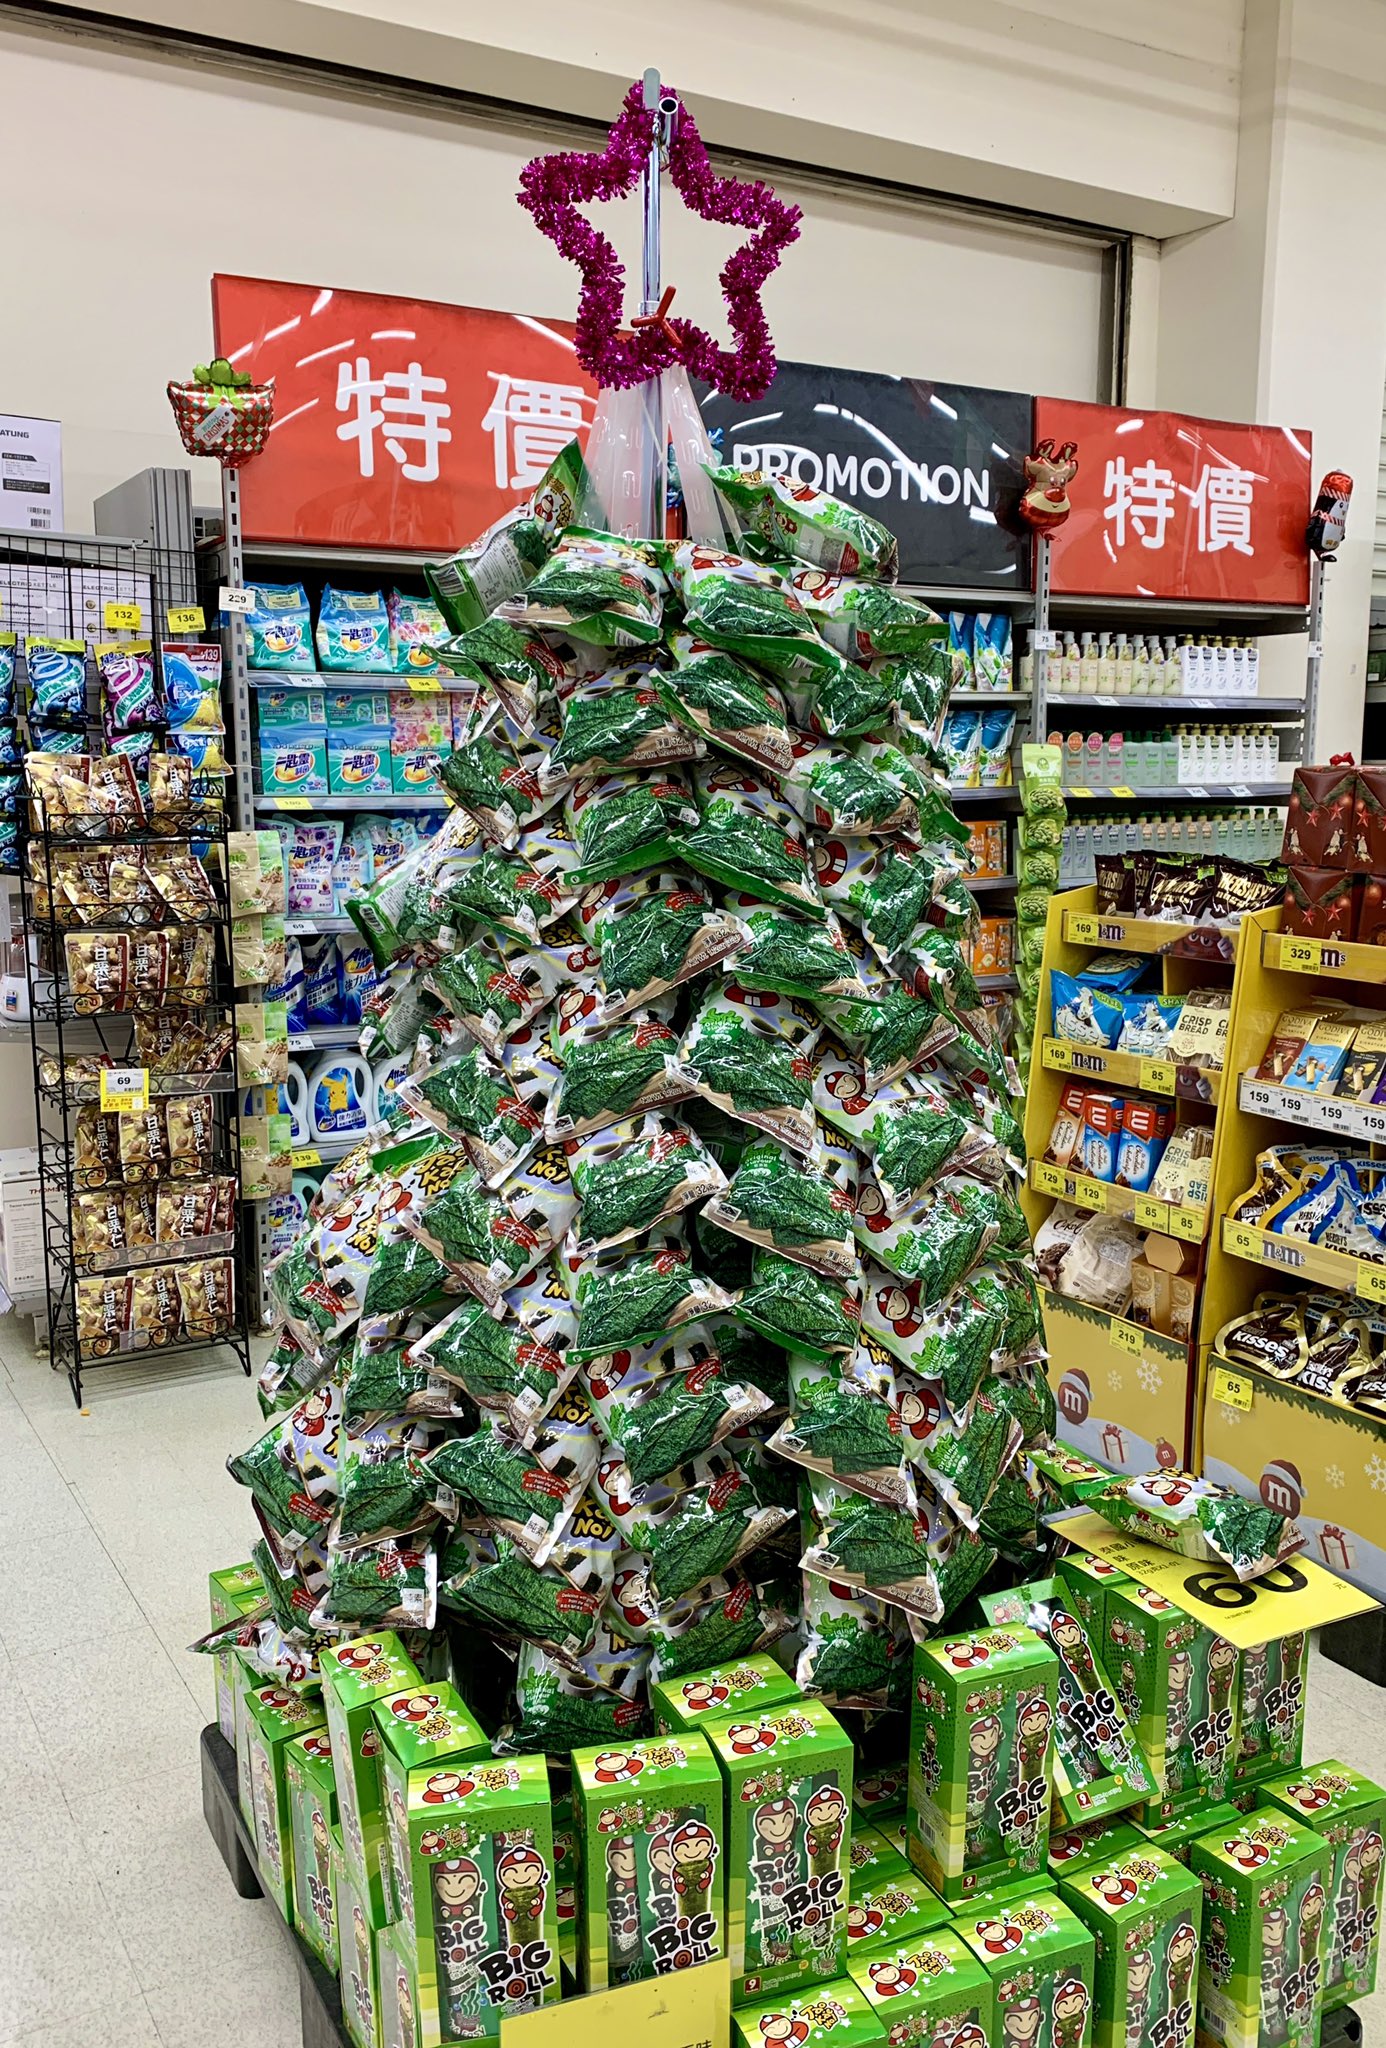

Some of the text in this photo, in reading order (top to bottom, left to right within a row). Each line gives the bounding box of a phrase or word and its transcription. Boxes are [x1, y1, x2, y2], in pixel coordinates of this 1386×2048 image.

[335, 356, 586, 490] 特價
[732, 443, 990, 507] PROMOTION
[1103, 455, 1255, 557] 特價
[228, 594, 247, 604] 229
[114, 610, 133, 620] 132
[176, 614, 195, 623] 136
[274, 753, 314, 771] 一匙靈
[341, 754, 379, 771] 一匙靈
[1075, 924, 1091, 934] 169
[1290, 947, 1311, 960] 329
[94, 946, 111, 990] 甘栗仁
[134, 943, 149, 986] 甘栗仁
[1178, 1024, 1210, 1036] BREAD
[1182, 1014, 1212, 1027] CRISP
[1318, 1022, 1351, 1036] GODIVA
[1050, 1049, 1066, 1059] 169
[117, 1076, 131, 1085] 69
[1152, 1071, 1164, 1081] 85
[1066, 1090, 1084, 1109] LU
[1249, 1091, 1270, 1104] 159
[1281, 1098, 1302, 1111] 159
[1091, 1106, 1107, 1127] LU
[1131, 1110, 1150, 1132] LU
[1321, 1106, 1342, 1120] 159
[1363, 1116, 1385, 1130] 159
[145, 1115, 162, 1158] 甘栗仁
[190, 1110, 206, 1152] 甘栗仁
[1167, 1146, 1191, 1160] CRIS
[1043, 1172, 1058, 1184] 129
[1083, 1187, 1100, 1200] 129
[181, 1194, 196, 1236] 甘栗仁
[1145, 1206, 1157, 1218] 85
[106, 1205, 124, 1248] 甘栗仁
[1181, 1218, 1193, 1229] 85
[1236, 1234, 1250, 1247] 65
[203, 1270, 220, 1314] 甘栗仁
[1371, 1277, 1386, 1290] 65
[155, 1277, 171, 1321] 甘栗仁
[103, 1289, 117, 1333] 甘栗仁
[1118, 1329, 1136, 1346] 219
[1227, 1381, 1241, 1393] 65
[1063, 1393, 1082, 1414] m
[1161, 1449, 1171, 1459] m
[1268, 1480, 1291, 1511] m
[1266, 1700, 1303, 1731] ROLL
[1085, 1713, 1125, 1749] ROLL
[1192, 1731, 1233, 1764] ROLL
[1000, 1801, 1048, 1835] ROLL
[311, 1898, 334, 1926] ROLL
[787, 1898, 845, 1935] ROLL
[439, 1942, 488, 1964] ROLL
[1342, 1926, 1377, 1960] ROLL
[655, 1942, 718, 1975] ROLL
[1205, 1957, 1232, 1979] ROLL
[487, 1969, 555, 2005] ROLL
[1285, 1981, 1321, 2017] ROLL
